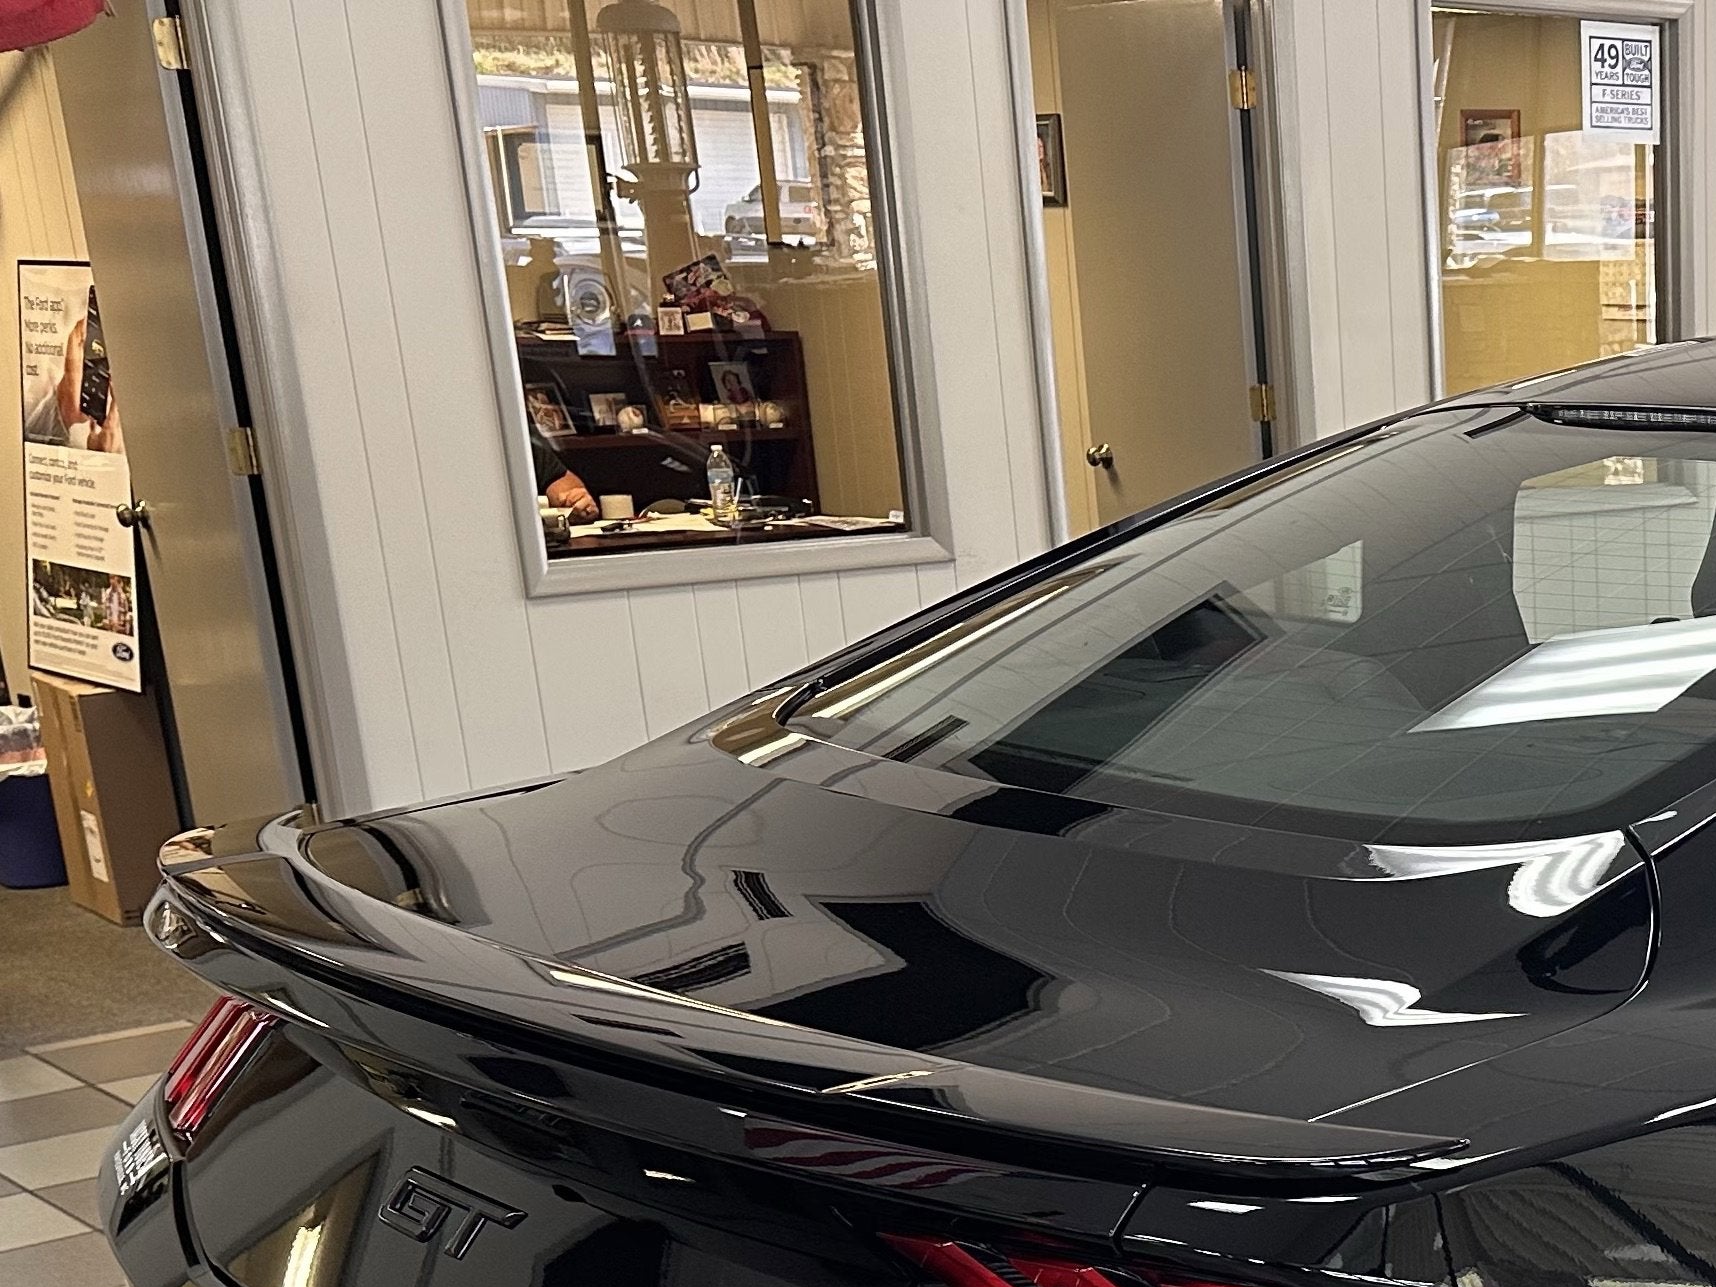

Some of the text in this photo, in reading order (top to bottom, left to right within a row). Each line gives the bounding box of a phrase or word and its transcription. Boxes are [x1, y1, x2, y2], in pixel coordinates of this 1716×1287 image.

[1593, 43, 1620, 69] 49
[1624, 43, 1649, 57] BUILT
[1594, 70, 1620, 81] YEARS
[1625, 72, 1650, 84] TOUGH
[1631, 107, 1648, 116] BEST
[1594, 115, 1649, 126] SELLING TRUCKS
[377, 1164, 529, 1262] GT
